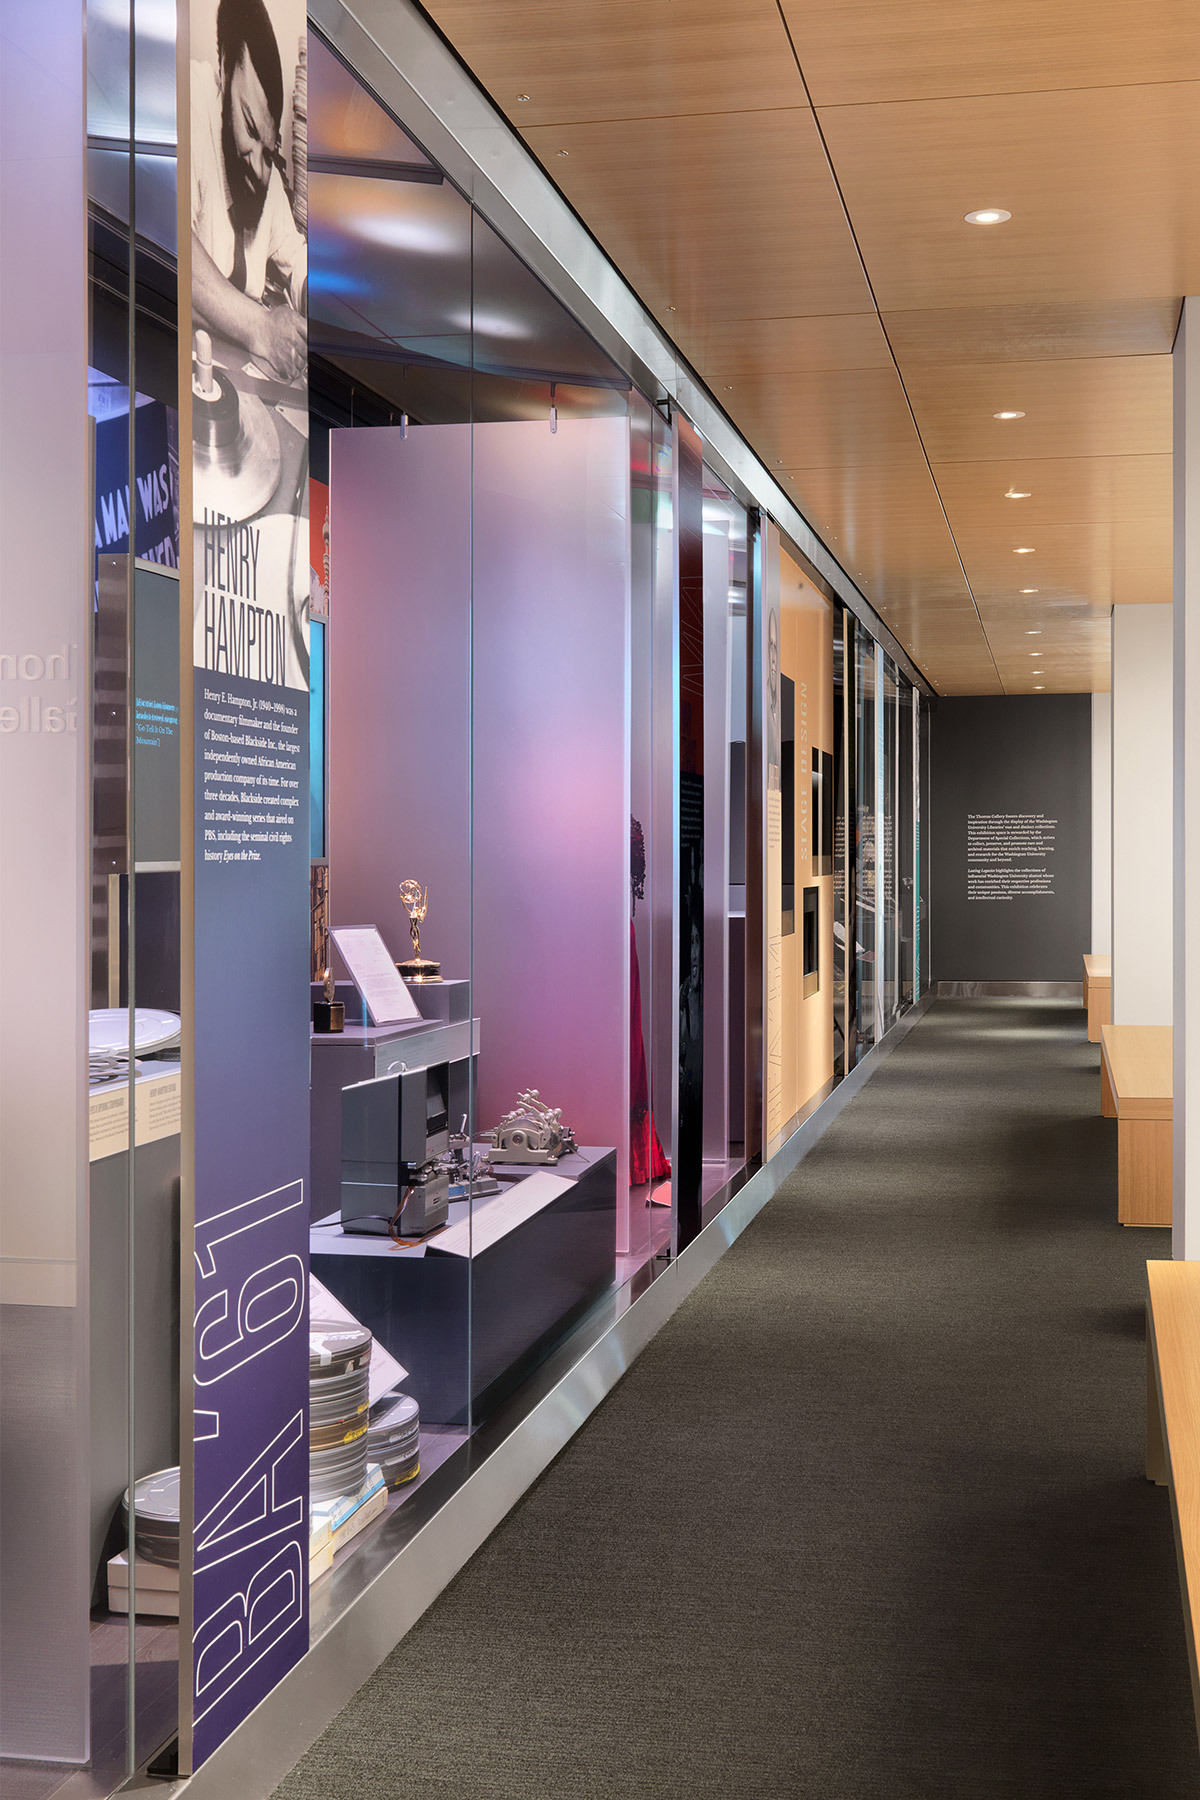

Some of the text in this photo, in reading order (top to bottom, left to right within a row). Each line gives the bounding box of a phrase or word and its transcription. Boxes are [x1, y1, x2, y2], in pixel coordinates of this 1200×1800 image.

[136, 464, 169, 522] WAS
[204, 507, 260, 601] HENRY
[204, 590, 286, 688] HAMPTON
[204, 688, 220, 704] Henry
[204, 708, 238, 727] documentary
[239, 715, 262, 728] filmmaker
[263, 720, 272, 730] and
[281, 722, 298, 734] founder
[204, 729, 211, 740] of
[211, 730, 244, 745] Boston-based
[245, 735, 267, 748] Blackside
[286, 741, 300, 754] largest
[204, 749, 296, 770] independently owned African American
[204, 770, 232, 782] production
[234, 774, 255, 787] company
[256, 774, 262, 784] of
[204, 789, 218, 800] three
[241, 792, 262, 804] Blackside
[263, 795, 280, 805] created
[281, 796, 299, 808] complex
[204, 809, 214, 820] and
[216, 810, 252, 825] award-winning
[253, 813, 265, 822] series
[266, 813, 275, 823] that
[276, 814, 287, 824] aired
[218, 830, 241, 844] including
[251, 831, 268, 841] seminal
[269, 832, 278, 842] civil
[280, 832, 292, 845] rights
[204, 849, 223, 863] history
[224, 850, 234, 863] Eyes
